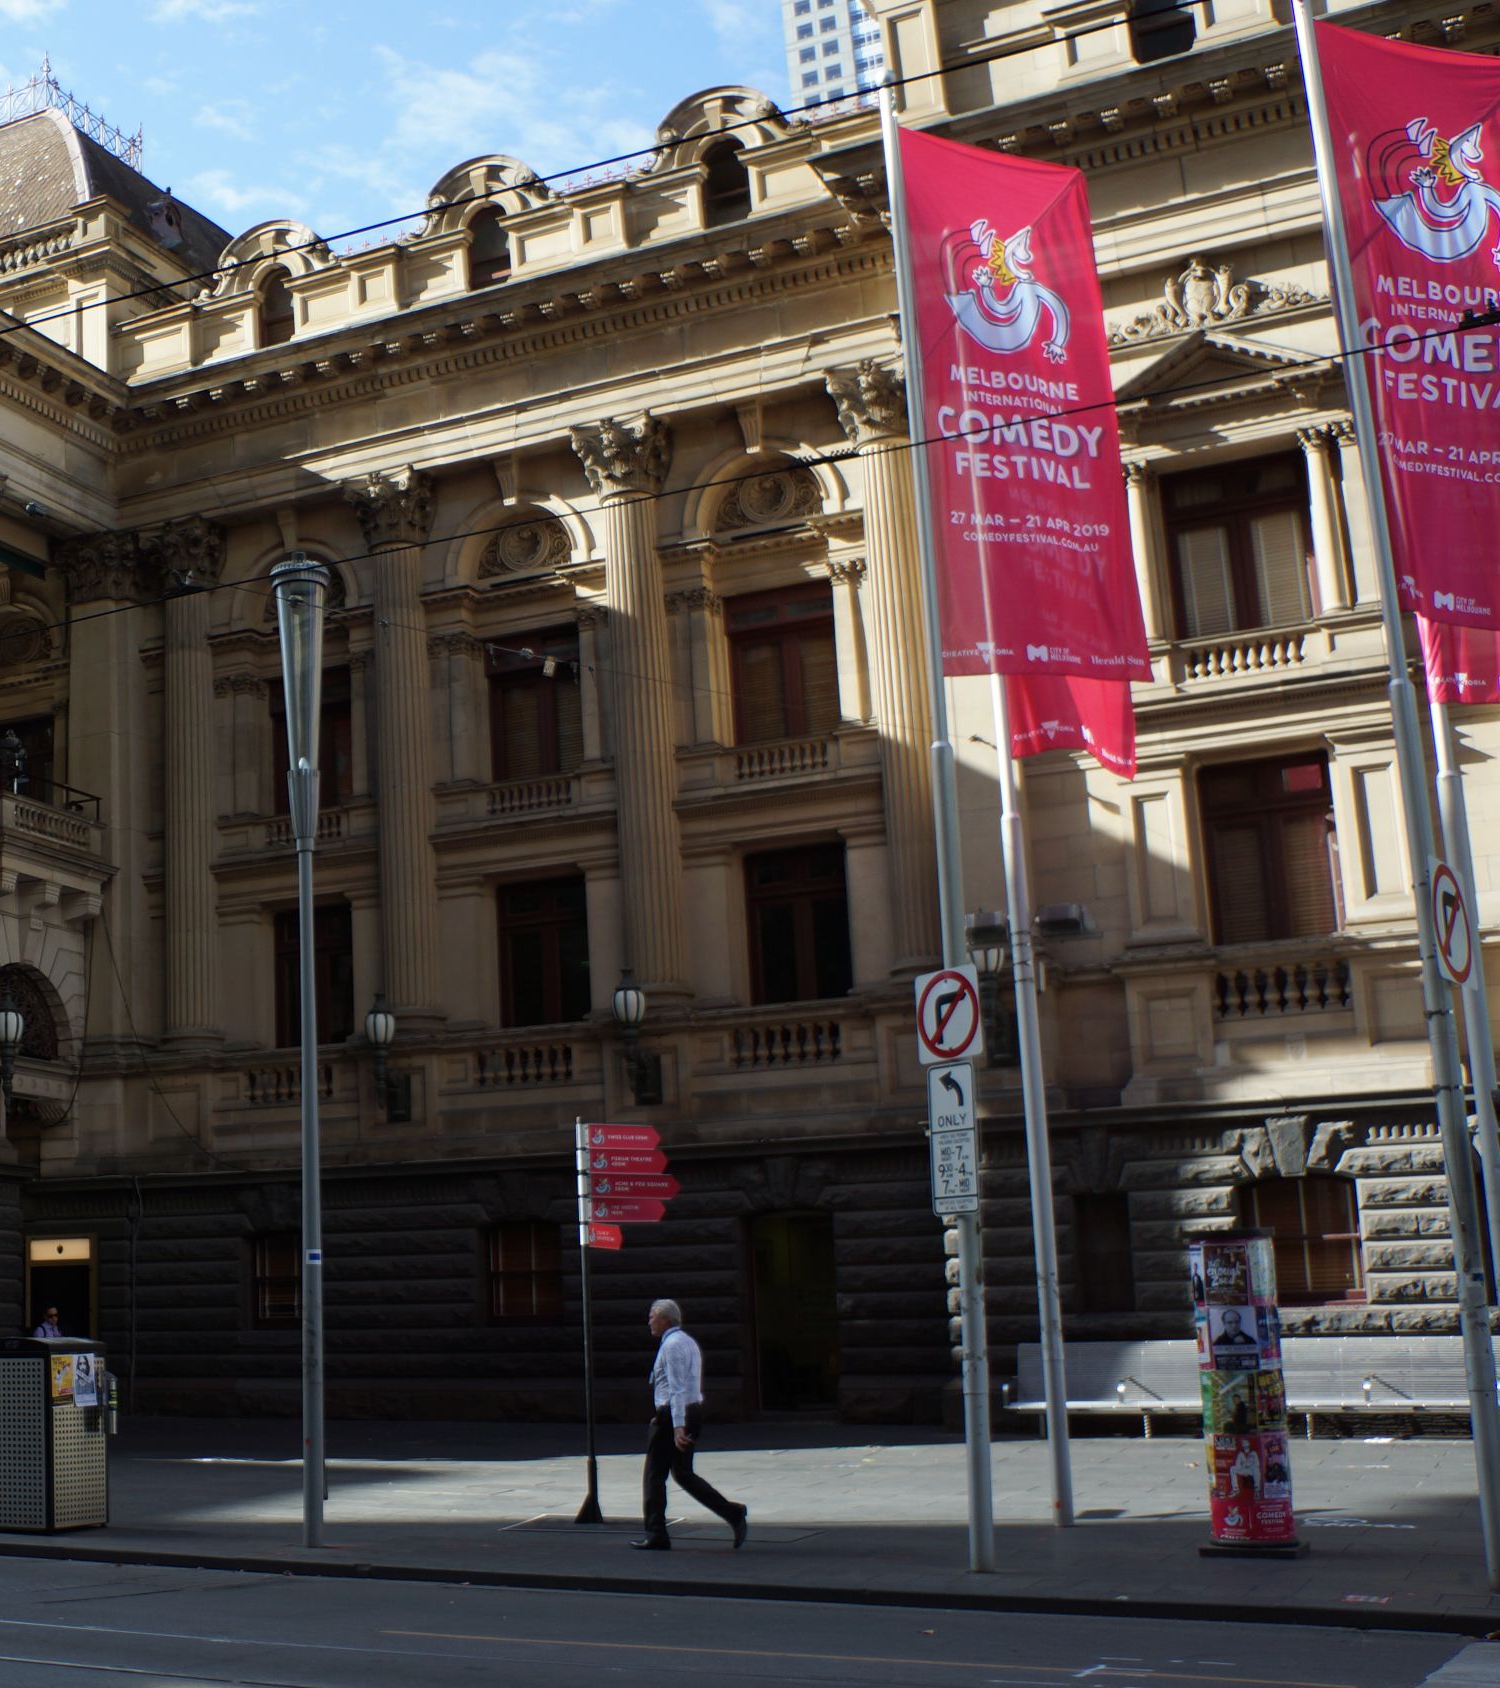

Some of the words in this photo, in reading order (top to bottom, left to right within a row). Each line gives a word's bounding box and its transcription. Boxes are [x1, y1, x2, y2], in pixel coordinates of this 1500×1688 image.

[1377, 275, 1500, 306] MELBOUR
[1360, 317, 1500, 373] COME
[950, 364, 1080, 400] MELBOURNE
[964, 390, 1066, 416] INTERNATIONAL
[938, 405, 1102, 458] COMEDY
[1394, 440, 1428, 455] MAR
[1448, 446, 1463, 461] 21
[956, 450, 1091, 489] FESTIVAL
[951, 512, 965, 524] 27
[971, 512, 1004, 526] MAR
[1026, 514, 1040, 528] 21
[1047, 518, 1070, 532] APR
[1073, 524, 1109, 537] 2019
[963, 531, 1098, 552] COMEDYFESTIVAL.COM.AU
[1456, 604, 1491, 616] MELBOURNE
[942, 649, 979, 658] CREATIVE
[1050, 655, 1081, 664] MELBOURNE
[1090, 655, 1124, 665] Herald
[1127, 656, 1144, 666] Sun
[938, 1115, 966, 1128] ONLY
